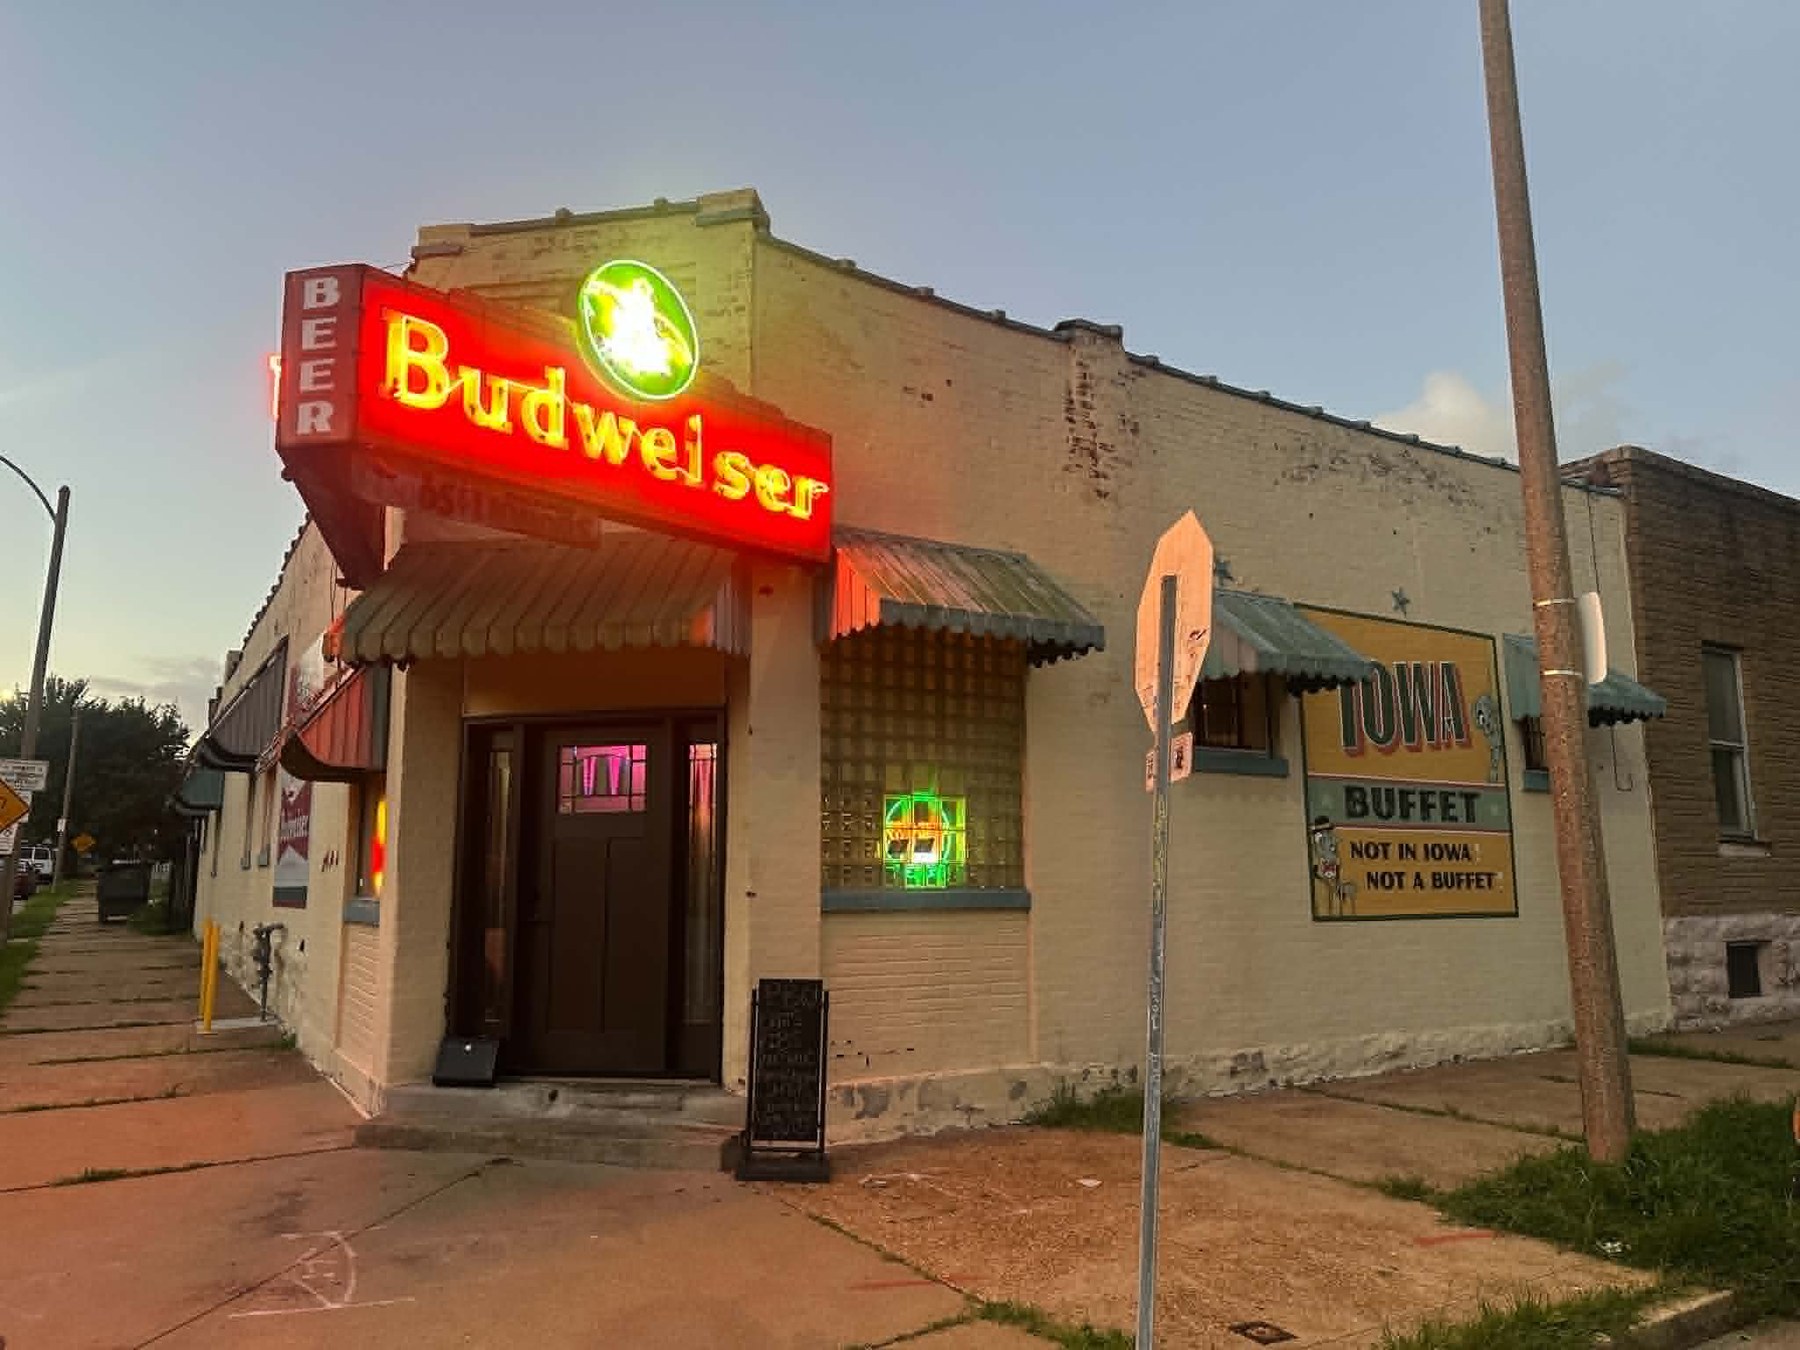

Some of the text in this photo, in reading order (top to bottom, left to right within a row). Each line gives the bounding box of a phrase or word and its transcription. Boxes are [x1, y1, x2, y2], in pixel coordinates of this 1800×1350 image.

[296, 275, 340, 436] BEER
[382, 308, 830, 521] Budweiser
[1338, 658, 1471, 756] IOWA
[1344, 785, 1480, 824] BUFFET
[1350, 841, 1391, 860] NOT
[1398, 843, 1417, 861] IN
[1366, 871, 1406, 891] NOT
[1412, 871, 1426, 890] A
